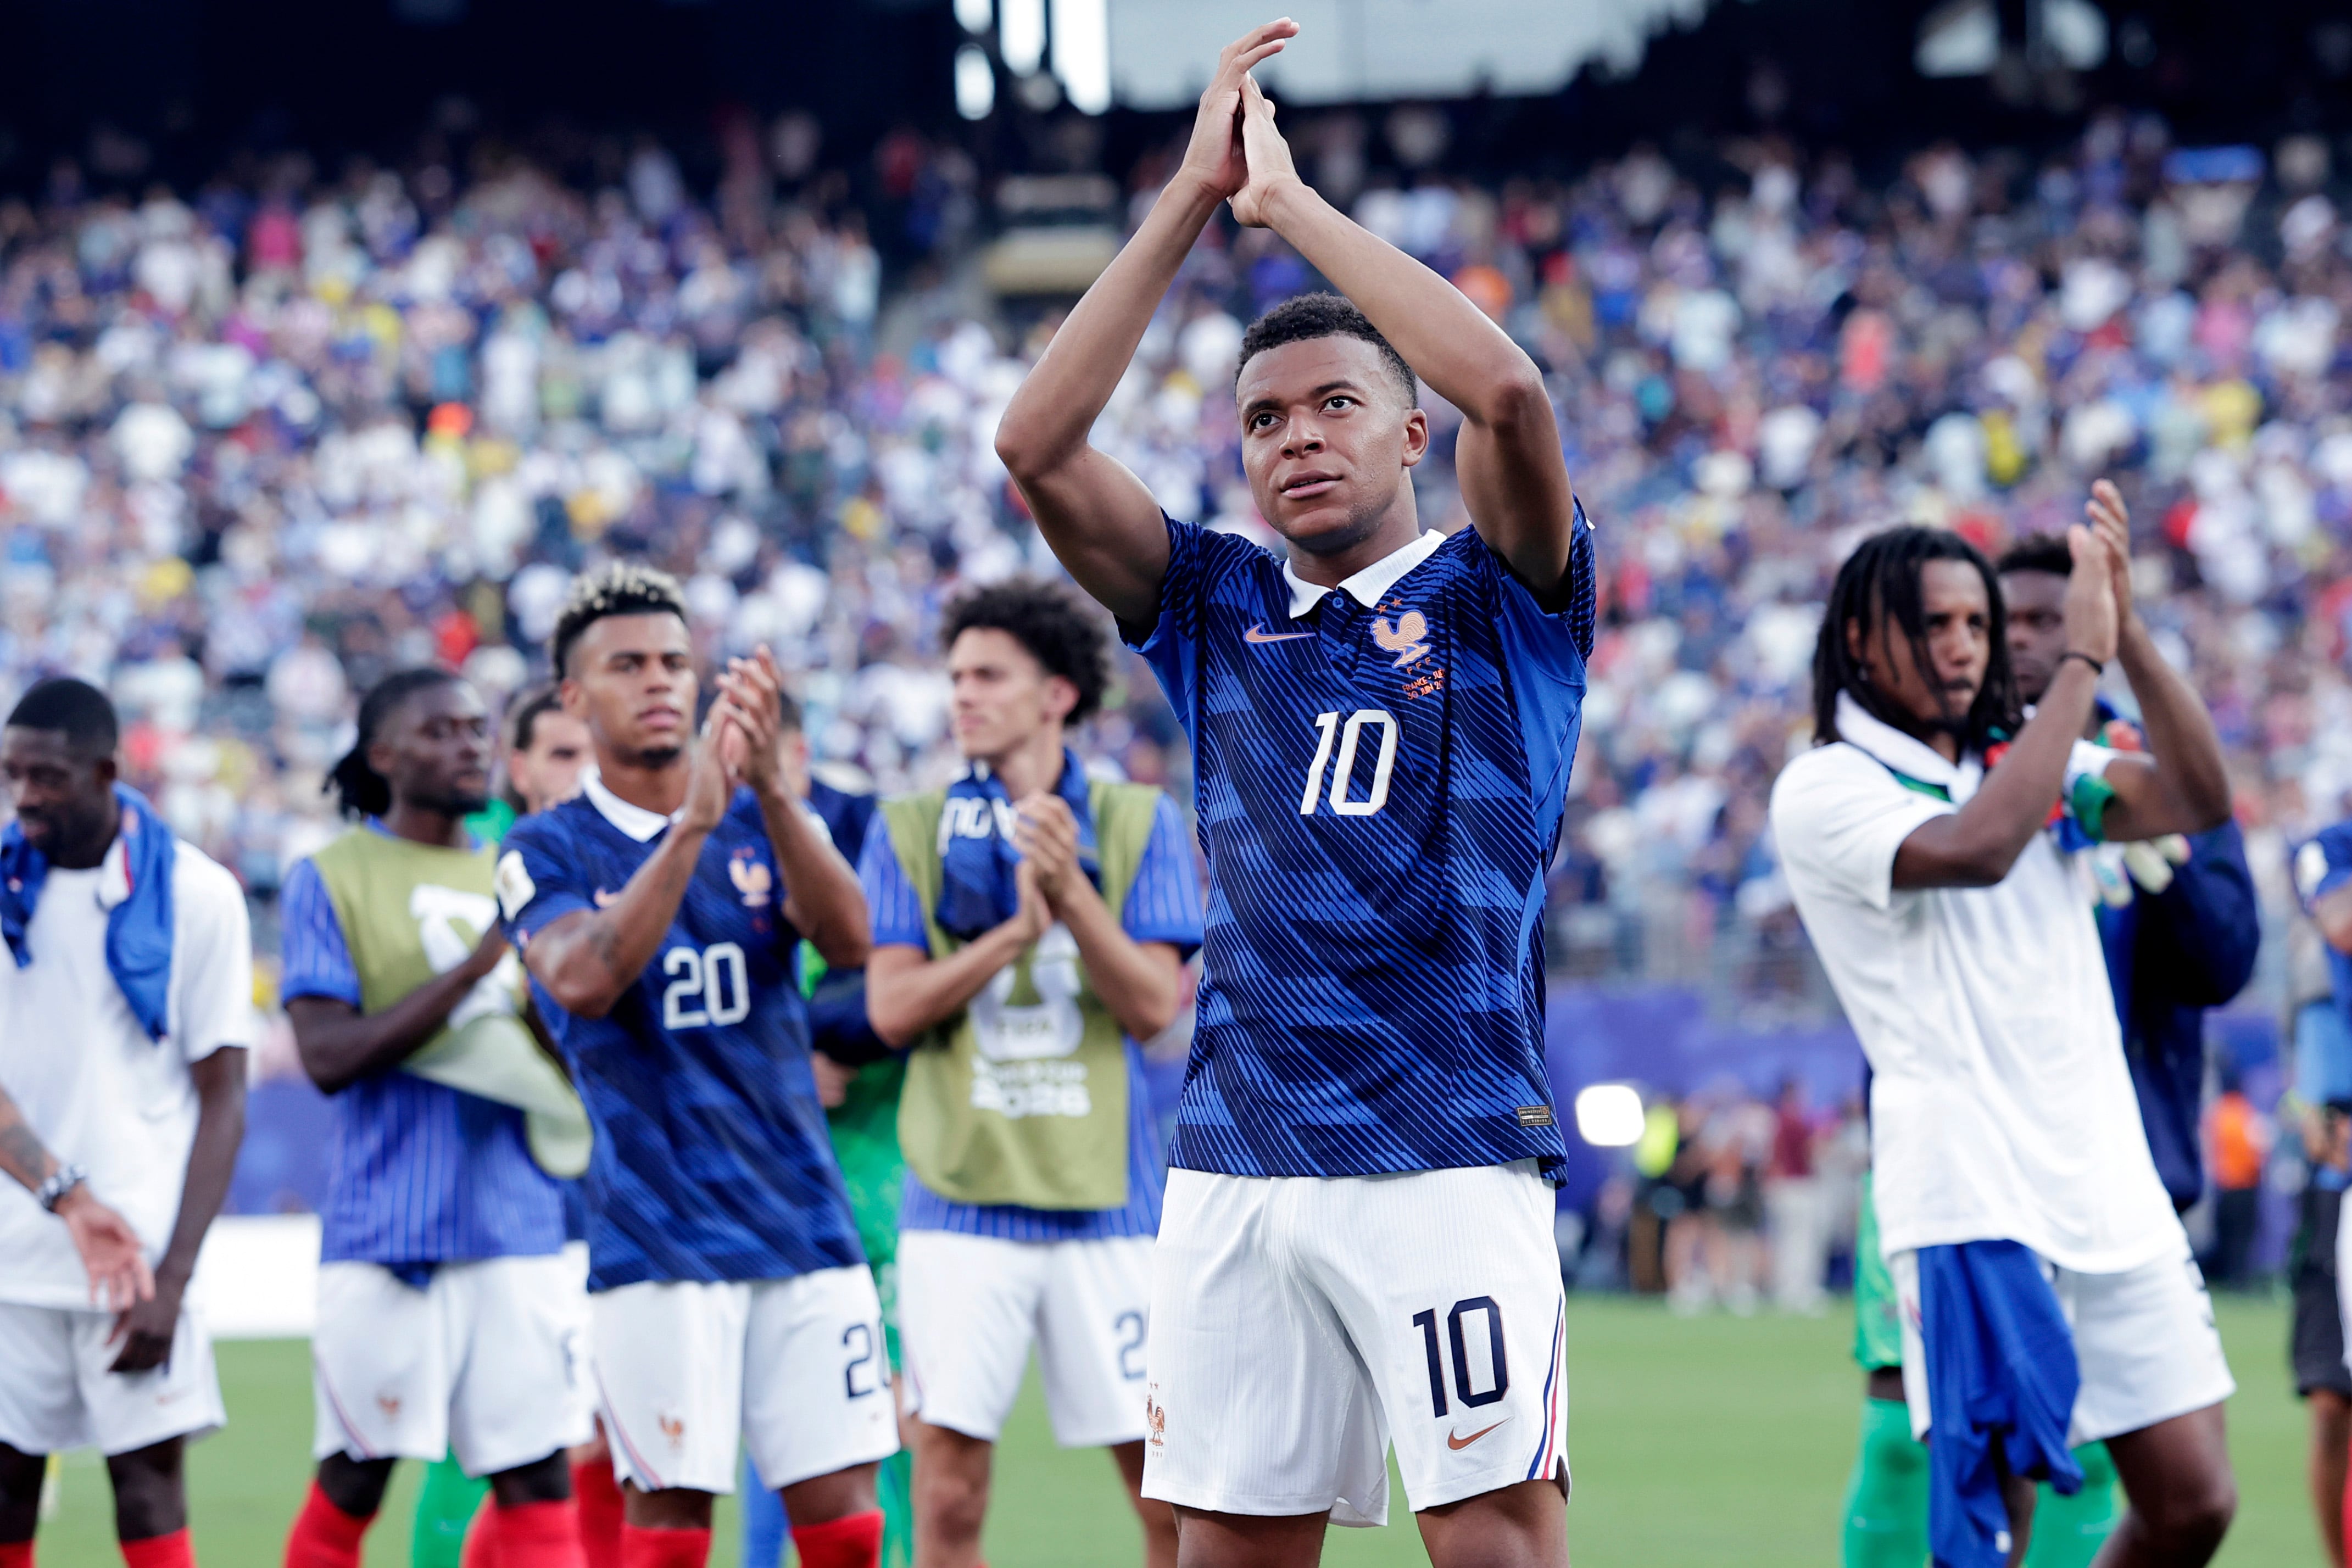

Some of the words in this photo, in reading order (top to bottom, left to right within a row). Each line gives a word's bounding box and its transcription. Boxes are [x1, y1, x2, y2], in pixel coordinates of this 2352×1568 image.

[1402, 676, 1428, 691] FRANCE
[1433, 667, 1446, 680] SUÈ
[1407, 691, 1419, 700] 30
[1420, 683, 1434, 696] JUIN
[1300, 709, 1398, 816] 10
[662, 941, 751, 1030] 20
[1413, 1295, 1510, 1418] 10
